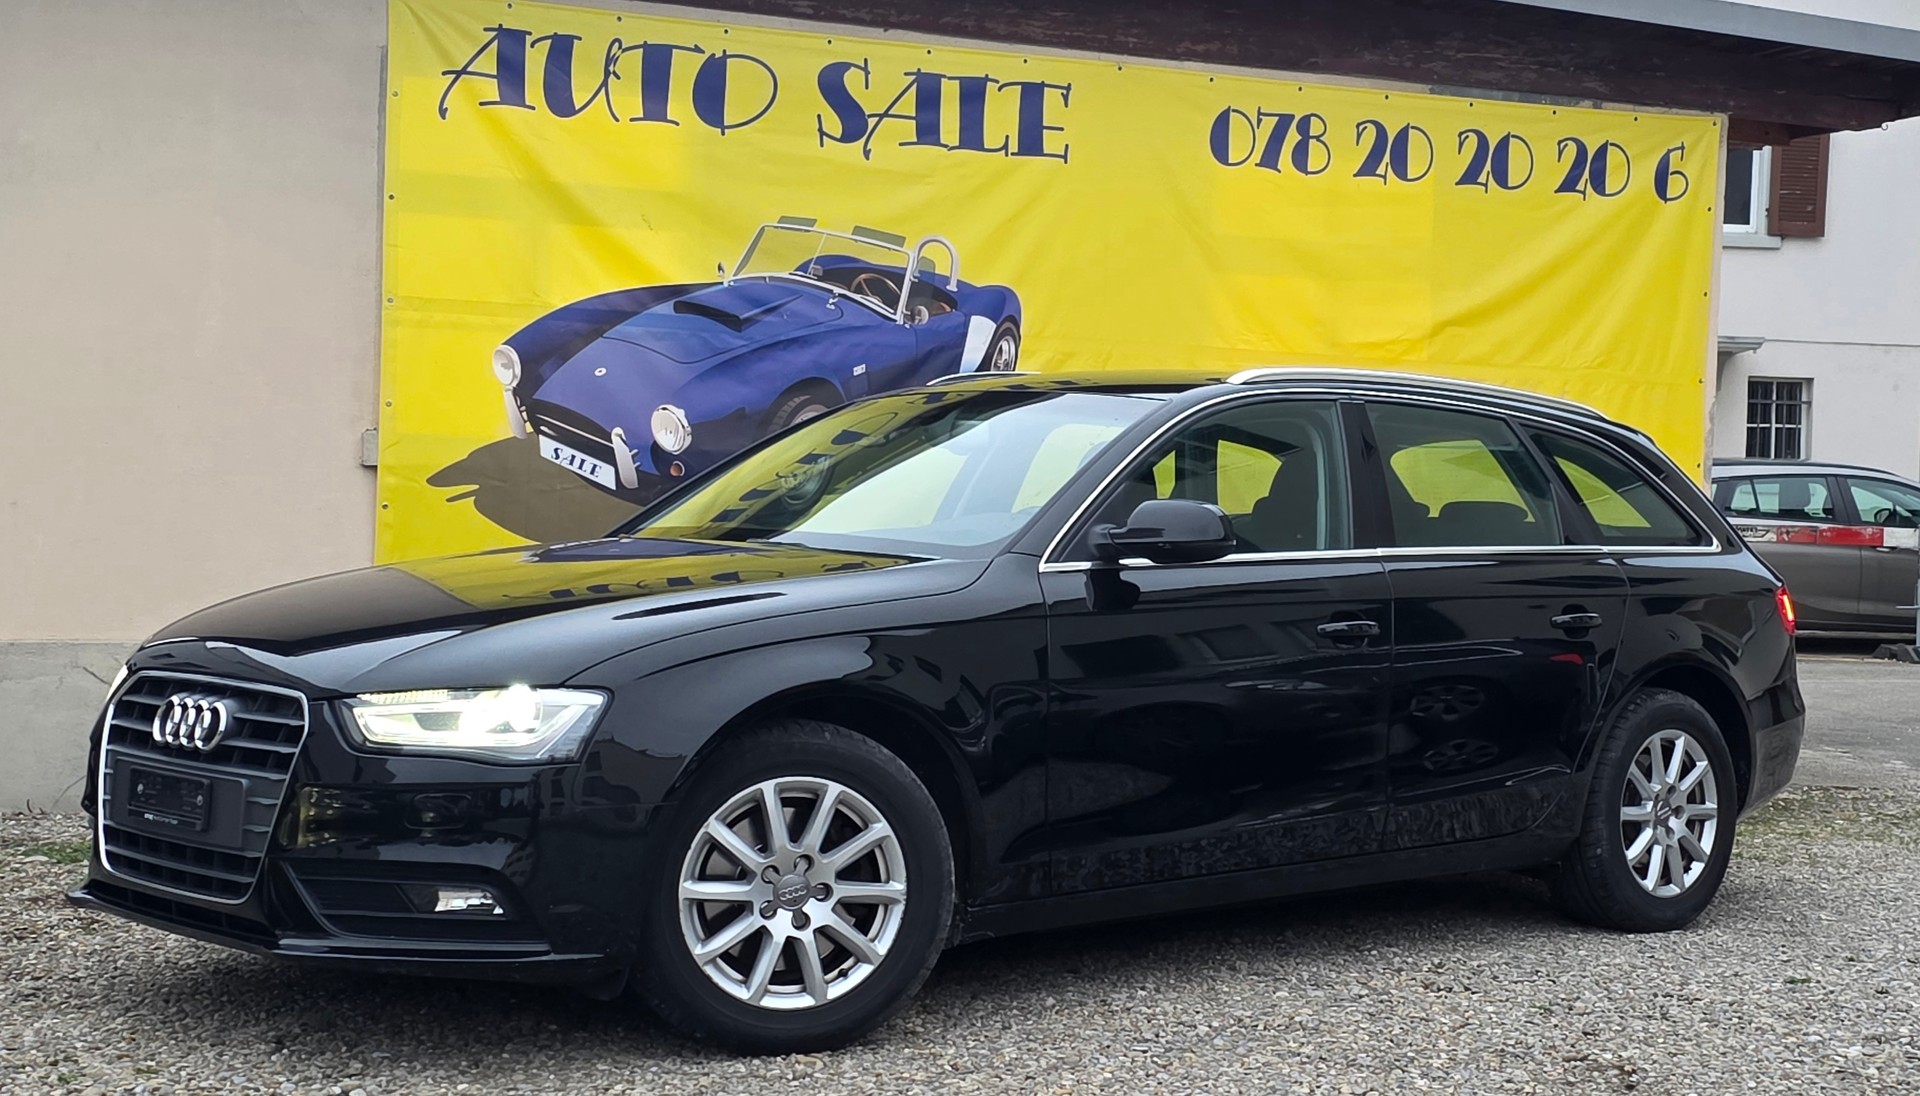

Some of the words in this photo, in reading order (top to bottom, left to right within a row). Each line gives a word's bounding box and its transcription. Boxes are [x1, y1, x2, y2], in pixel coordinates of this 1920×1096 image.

[440, 24, 778, 136] AUTO
[817, 58, 1071, 164] SALE
[1210, 106, 1331, 175] 078
[1353, 120, 1434, 185] 20
[1455, 129, 1534, 193] 20
[1554, 137, 1631, 201] 20
[1654, 142, 1689, 203] 6
[551, 447, 602, 478] SALE
